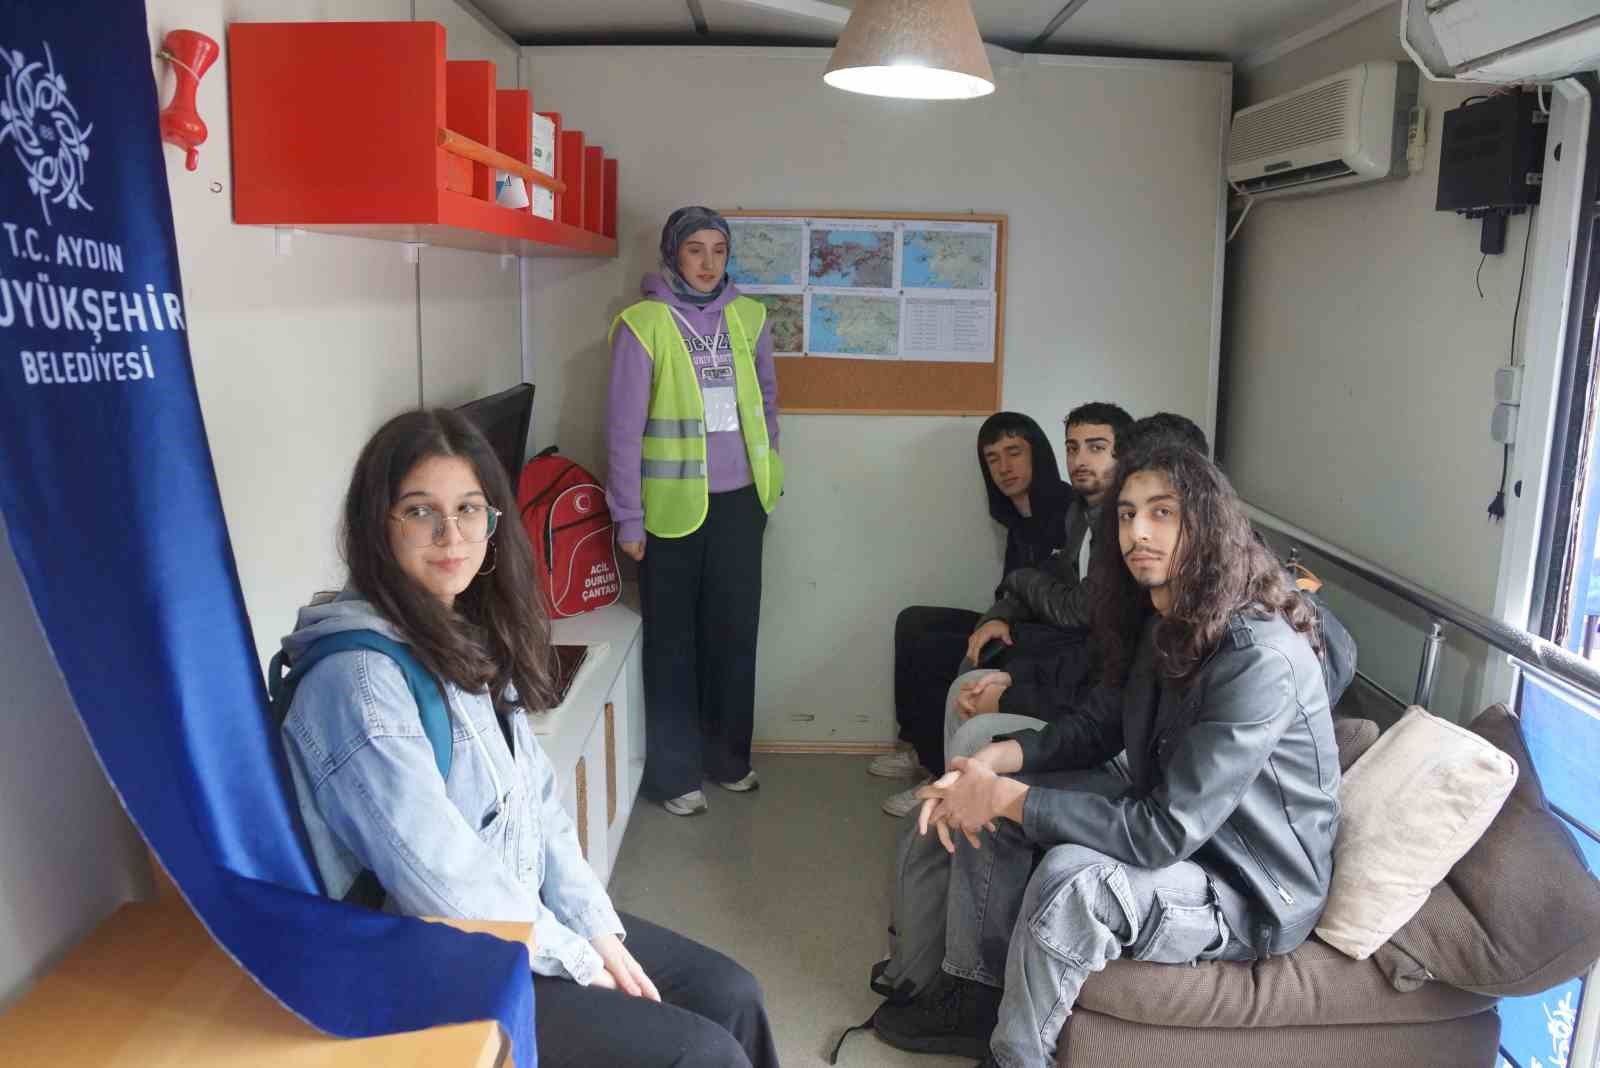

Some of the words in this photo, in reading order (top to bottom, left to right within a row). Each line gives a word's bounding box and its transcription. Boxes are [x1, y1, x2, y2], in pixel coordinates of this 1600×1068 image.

[3, 222, 51, 263] T.C.
[56, 234, 124, 273] AYDIN
[20, 344, 155, 384] BELEDİYESİ
[585, 573, 616, 588] DURUM
